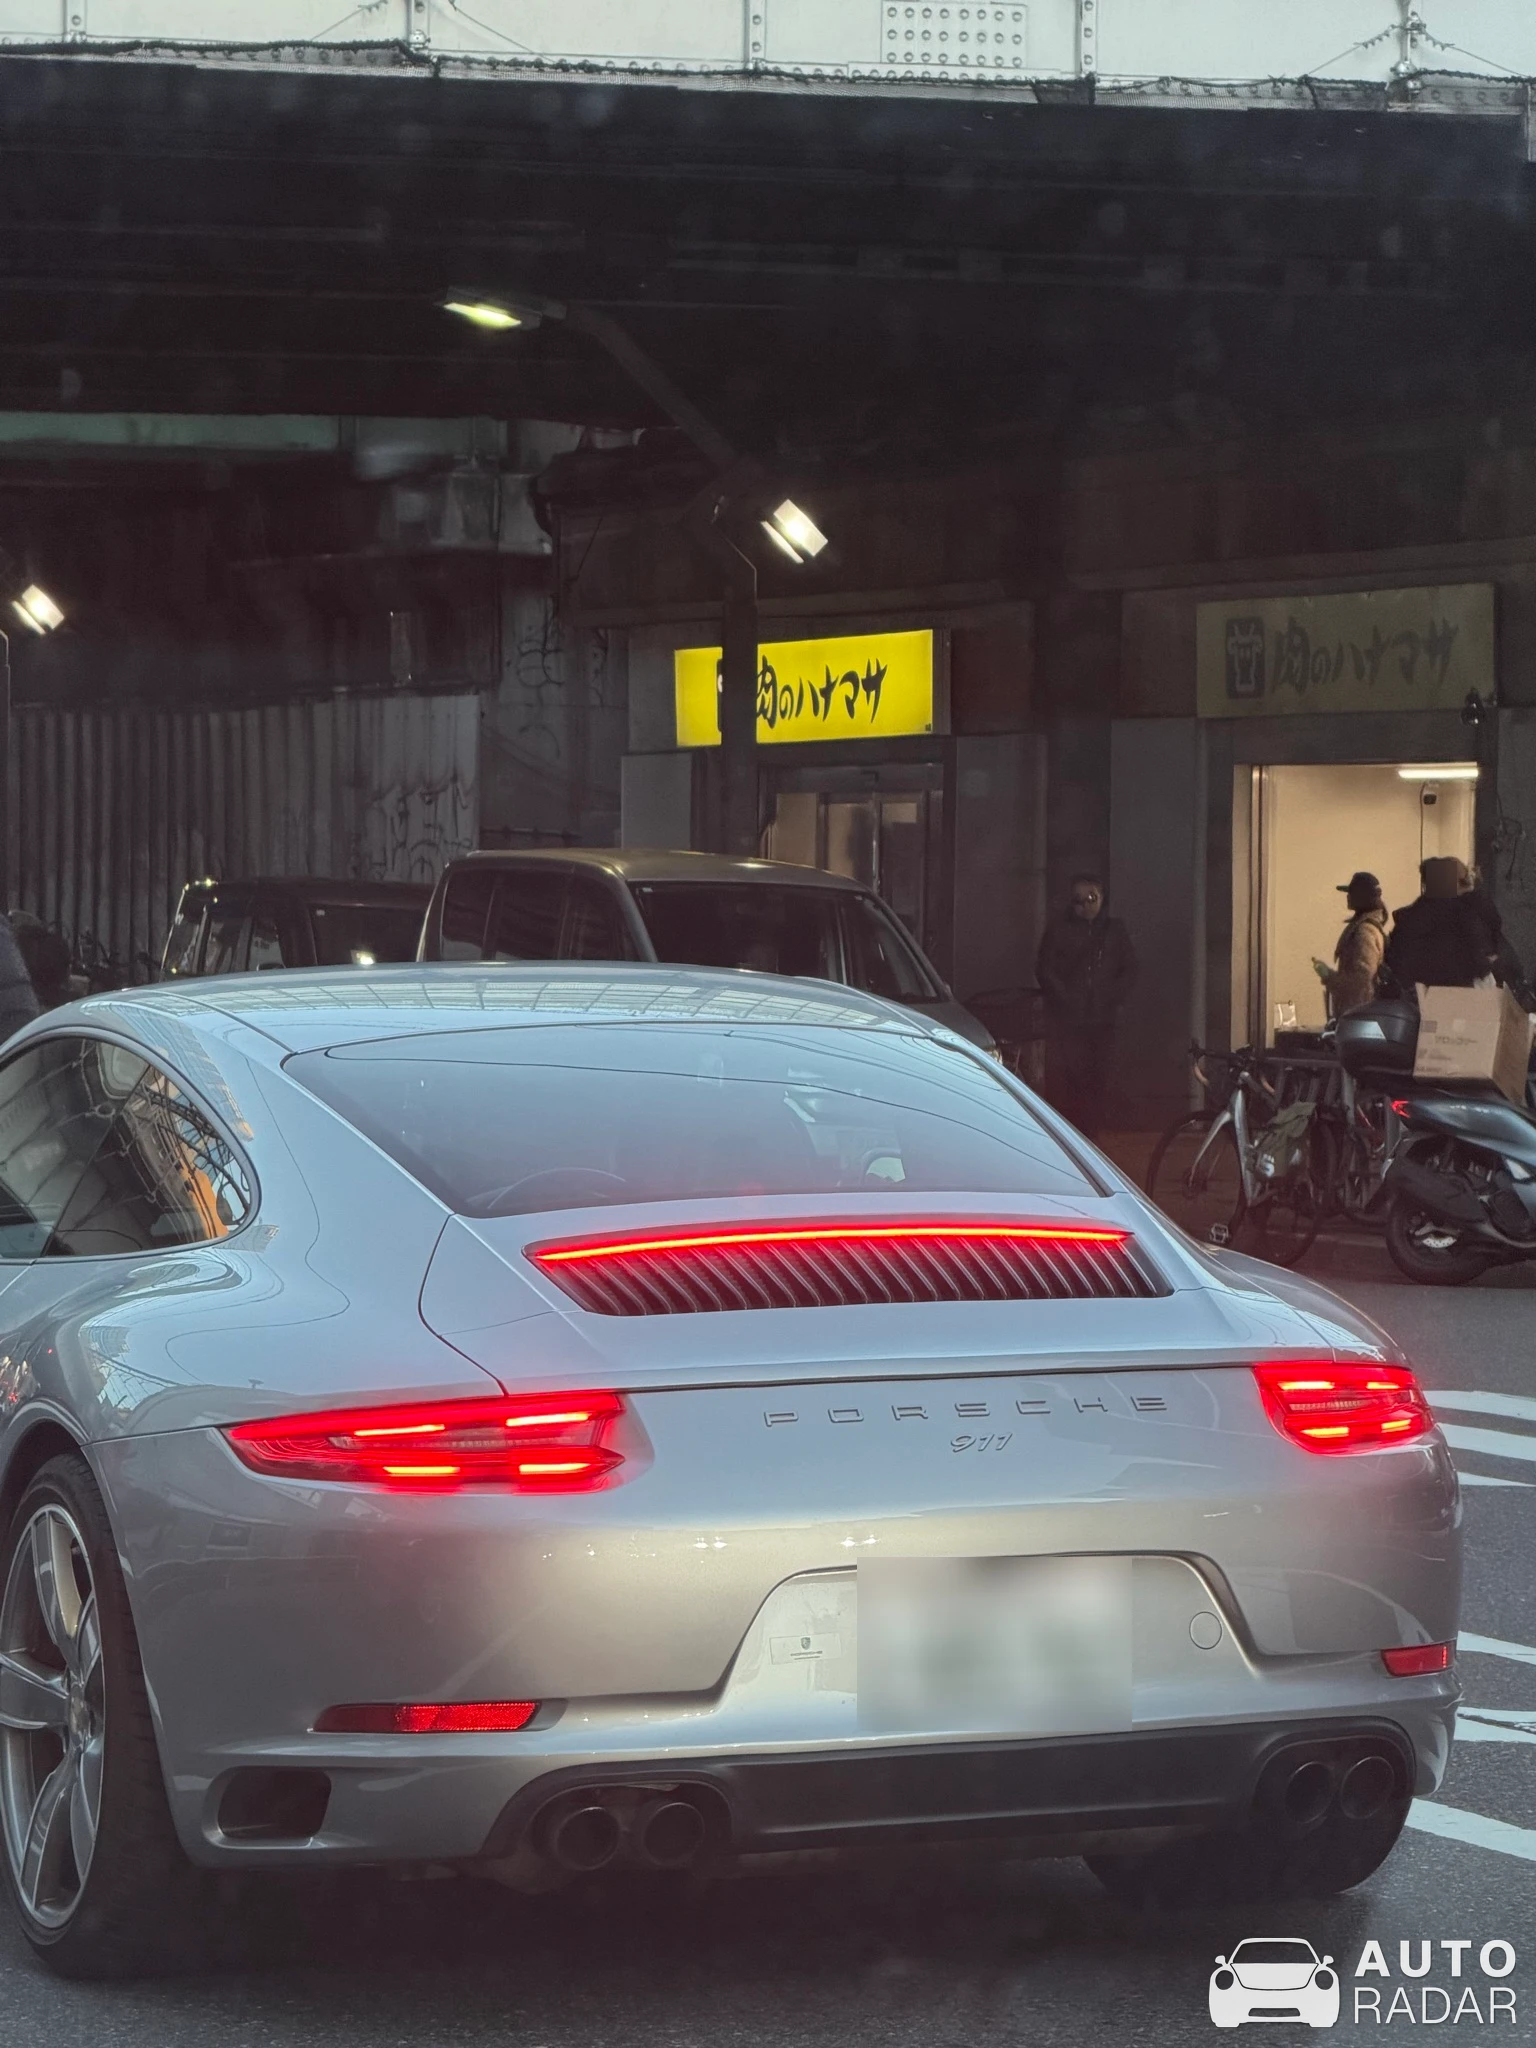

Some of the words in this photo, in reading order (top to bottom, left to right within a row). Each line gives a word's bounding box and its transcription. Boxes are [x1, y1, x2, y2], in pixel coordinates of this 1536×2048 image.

[1271, 616, 1459, 695] 肉のハナマサ
[764, 1395, 1168, 1427] PORSCHE
[950, 1432, 1013, 1453] 911
